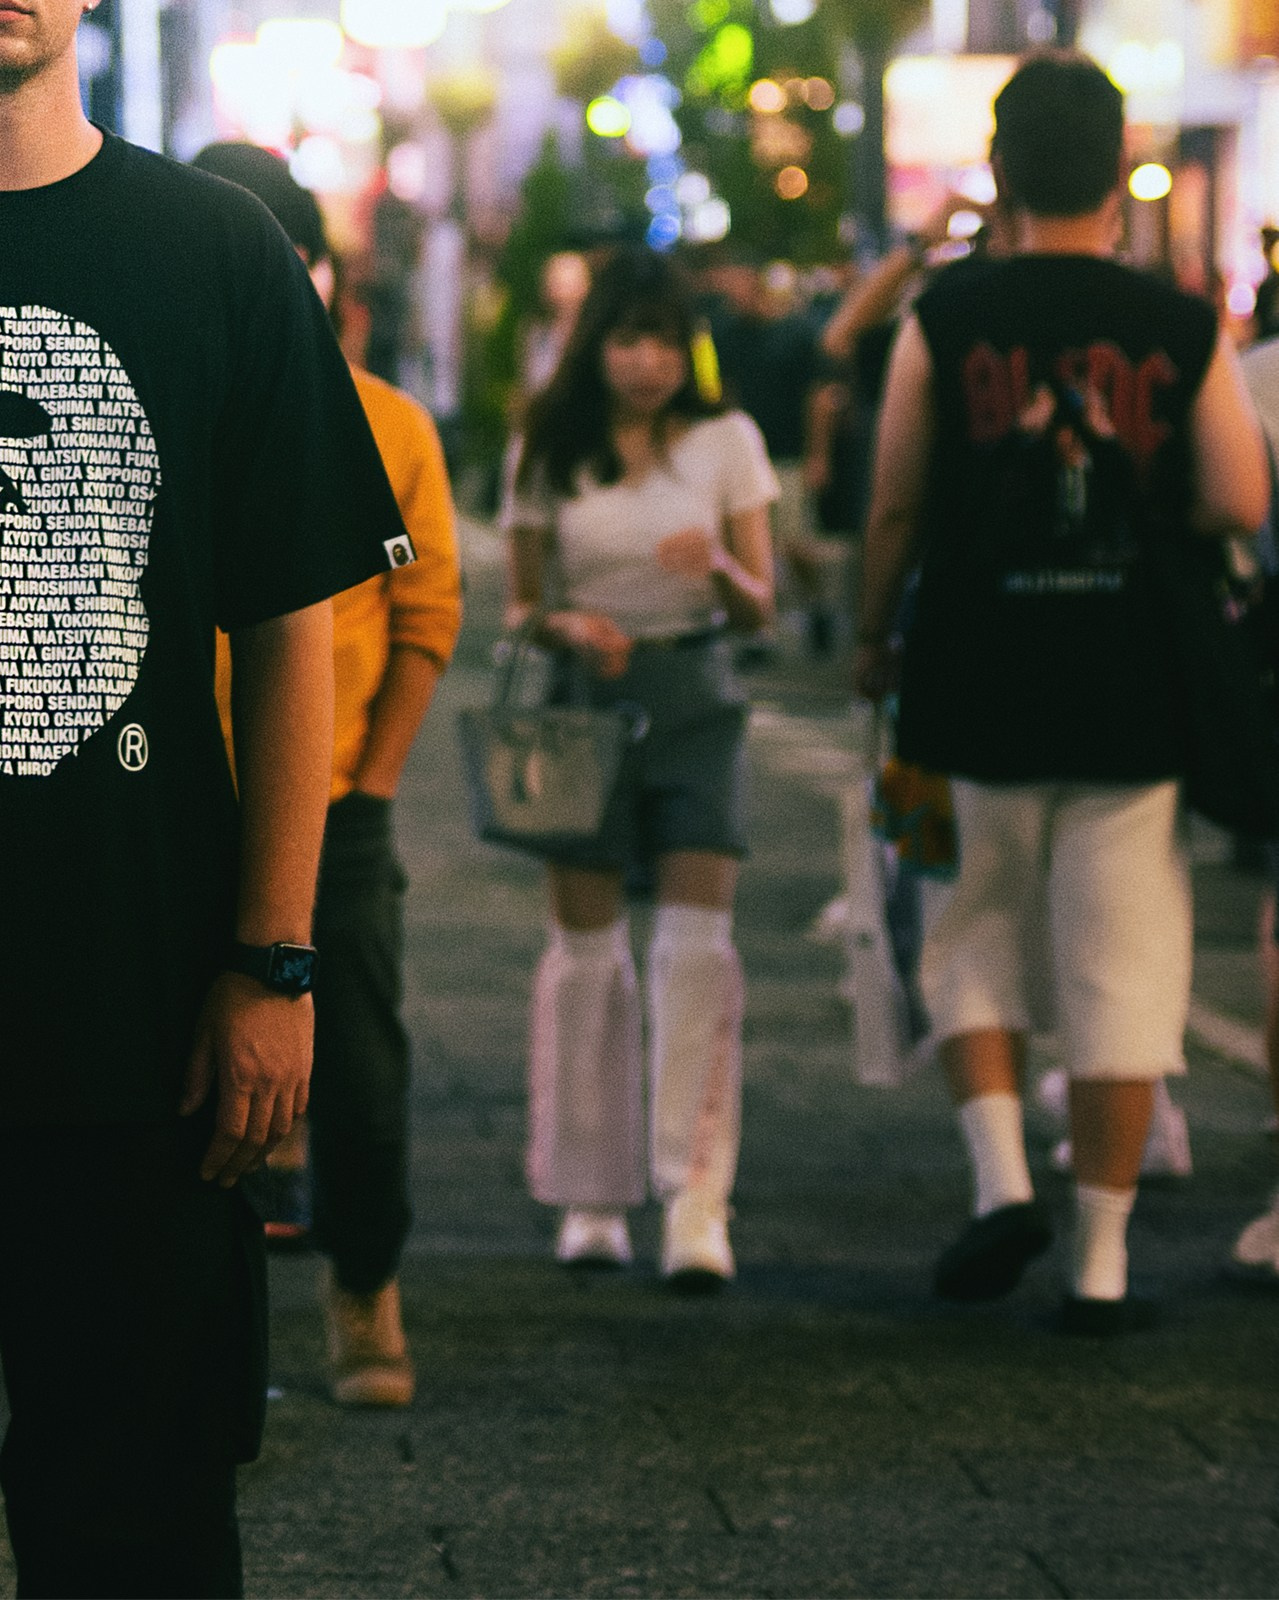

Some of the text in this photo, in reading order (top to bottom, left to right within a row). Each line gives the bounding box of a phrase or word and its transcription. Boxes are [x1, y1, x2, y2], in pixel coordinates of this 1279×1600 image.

[4, 319, 71, 335] FUKUOKA
[45, 337, 100, 351] SENDAI
[3, 351, 47, 367] KYOTO
[51, 352, 101, 367] OSAKA
[0, 367, 75, 383] HARAJUKU
[27, 384, 103, 399] MAEBASHI
[72, 416, 136, 434] SHIBUYA
[51, 433, 131, 450] YOKOHAMA
[136, 436, 156, 452] NA
[32, 449, 121, 466] MATSUYAMA
[40, 466, 83, 481] GINZA
[86, 466, 151, 484] SAPPORO
[22, 482, 79, 497] NAGOYA
[83, 483, 125, 498] KYOTO
[74, 499, 146, 516] HARAJUKU
[46, 515, 99, 530] SENDAI
[3, 530, 48, 546] KYOTO
[52, 531, 101, 546] OSAKA
[0, 547, 76, 563] HARAJUKU
[80, 548, 130, 564] AOYAMA
[27, 563, 104, 578] MAEBASHI
[15, 580, 97, 595] HIROSHIMA
[10, 596, 70, 612] AOYAMA
[74, 597, 125, 613] SHIBUYA
[52, 613, 126, 630] YOKOHAMA
[33, 629, 121, 645] MATSUYAMA
[41, 646, 85, 661] GINZA
[89, 645, 138, 664] SAPPORO
[22, 662, 82, 677] NAGOYA
[86, 662, 125, 679] KYOTO
[5, 678, 72, 693] FUKUOKA
[48, 695, 102, 710] SENDAI
[4, 711, 50, 727] KYOTO
[54, 711, 104, 727] OSAKA
[1, 728, 79, 743] HARAJUKU
